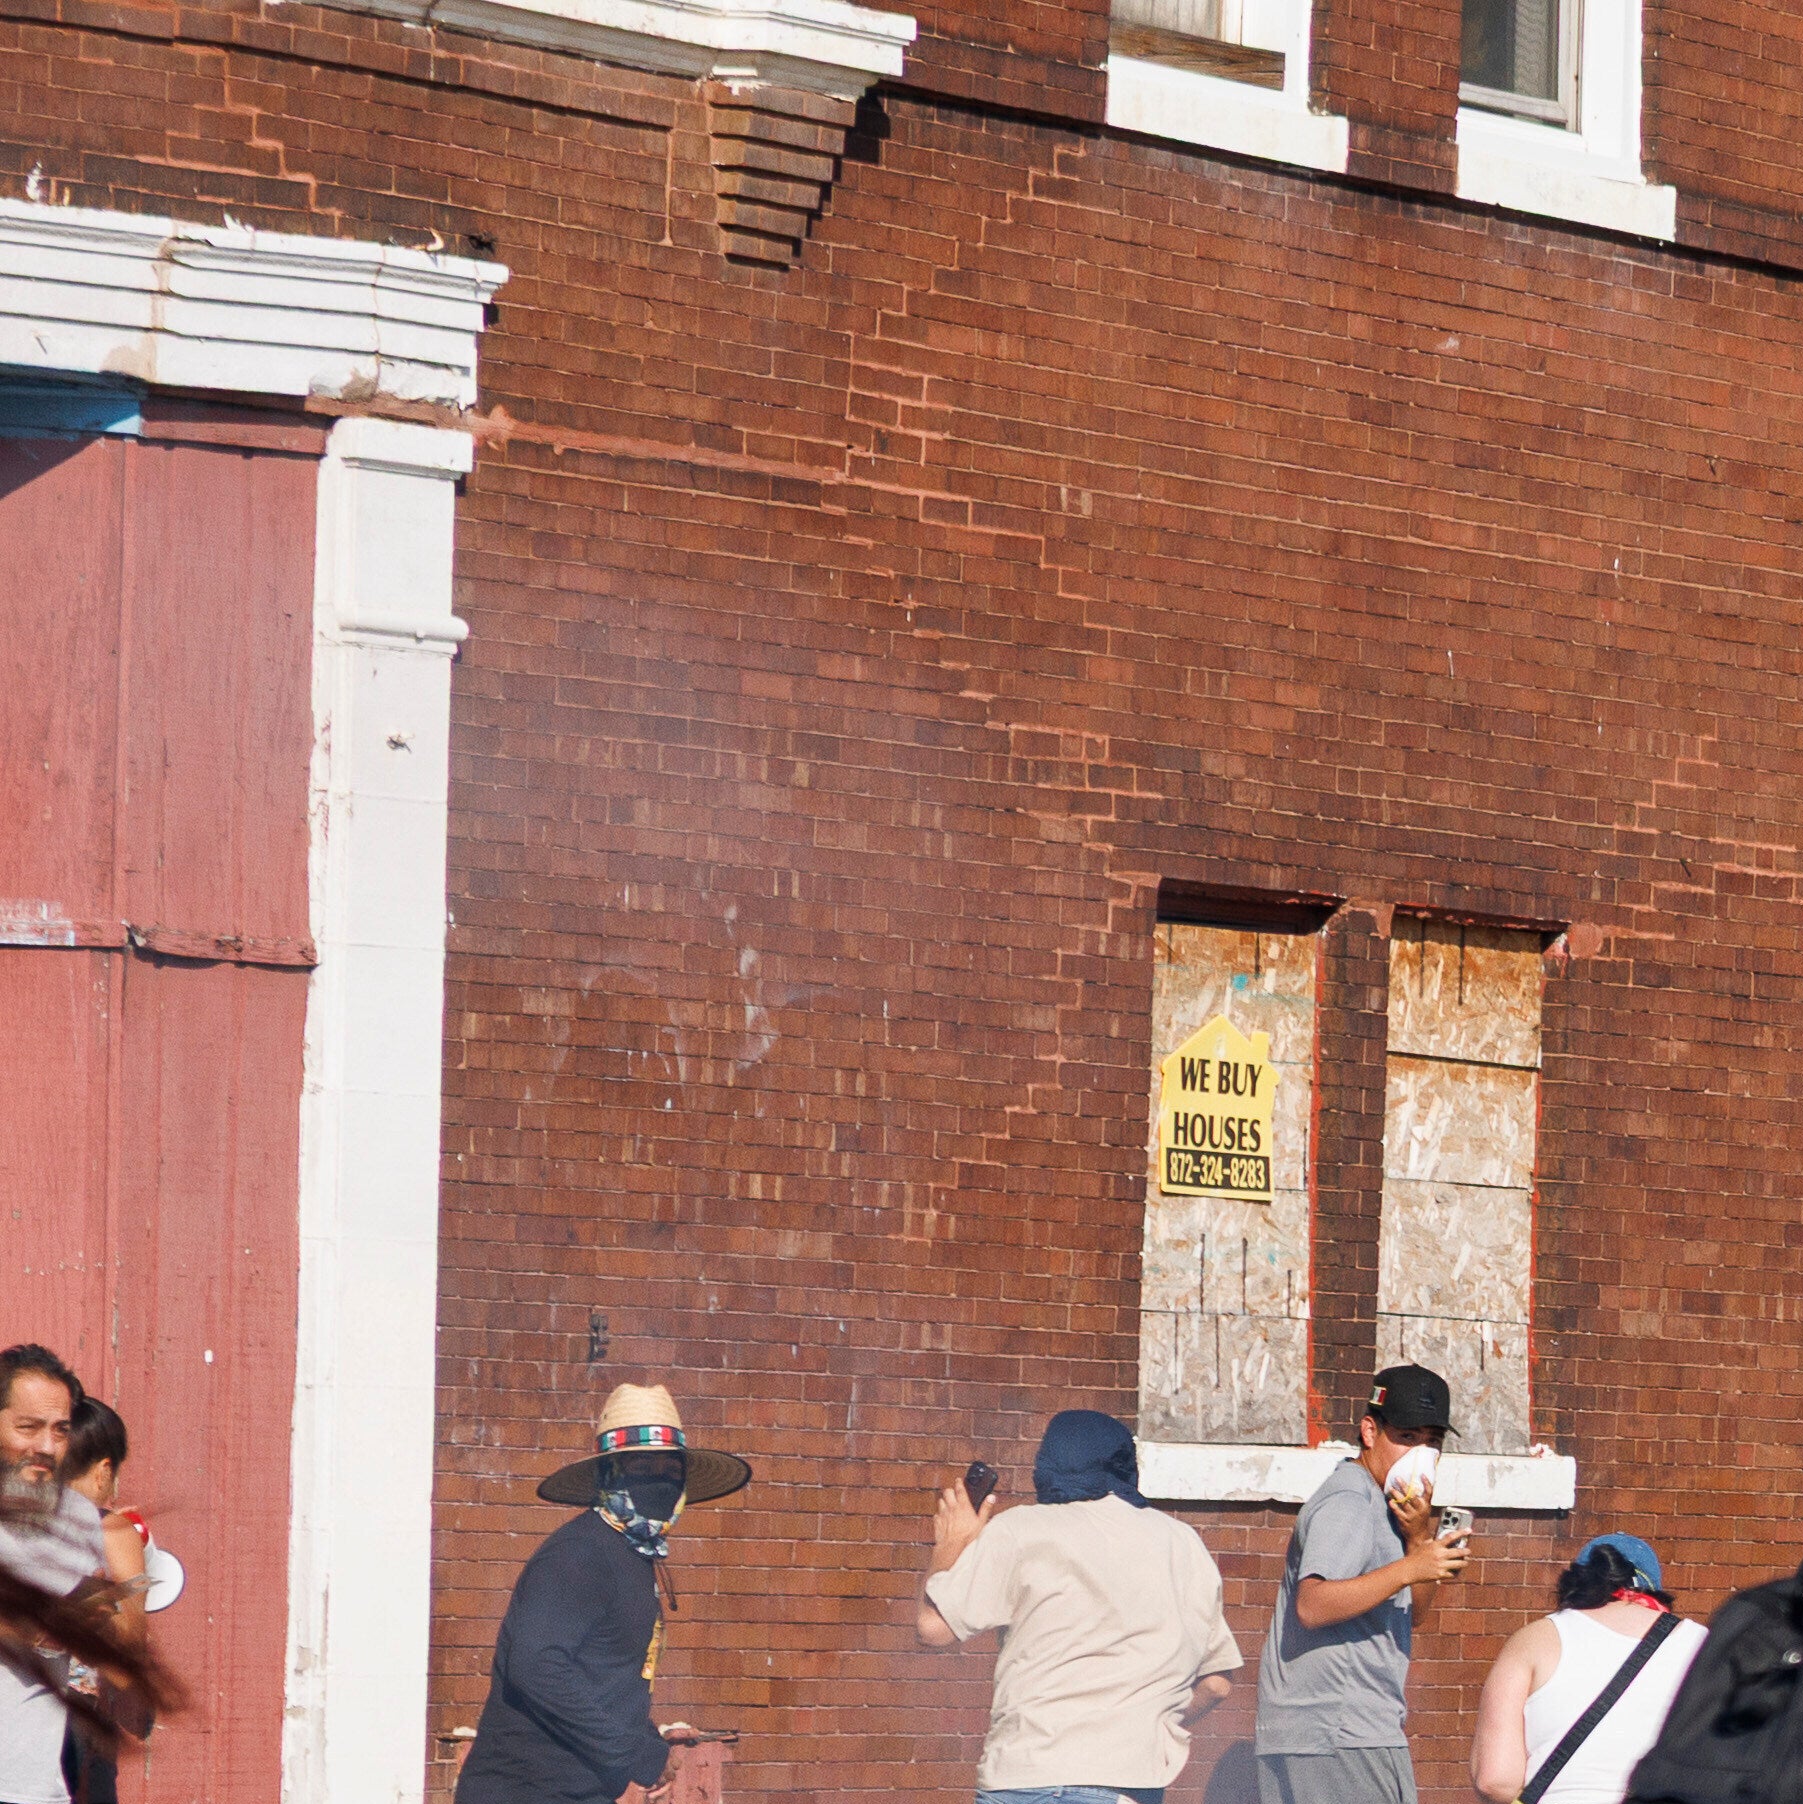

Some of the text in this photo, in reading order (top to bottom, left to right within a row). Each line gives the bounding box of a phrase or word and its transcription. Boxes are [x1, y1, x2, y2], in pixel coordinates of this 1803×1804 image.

[1180, 1056, 1263, 1098] WE BUY
[1173, 1111, 1262, 1153] HOUSES
[1169, 1151, 1266, 1190] 872-324-8283
